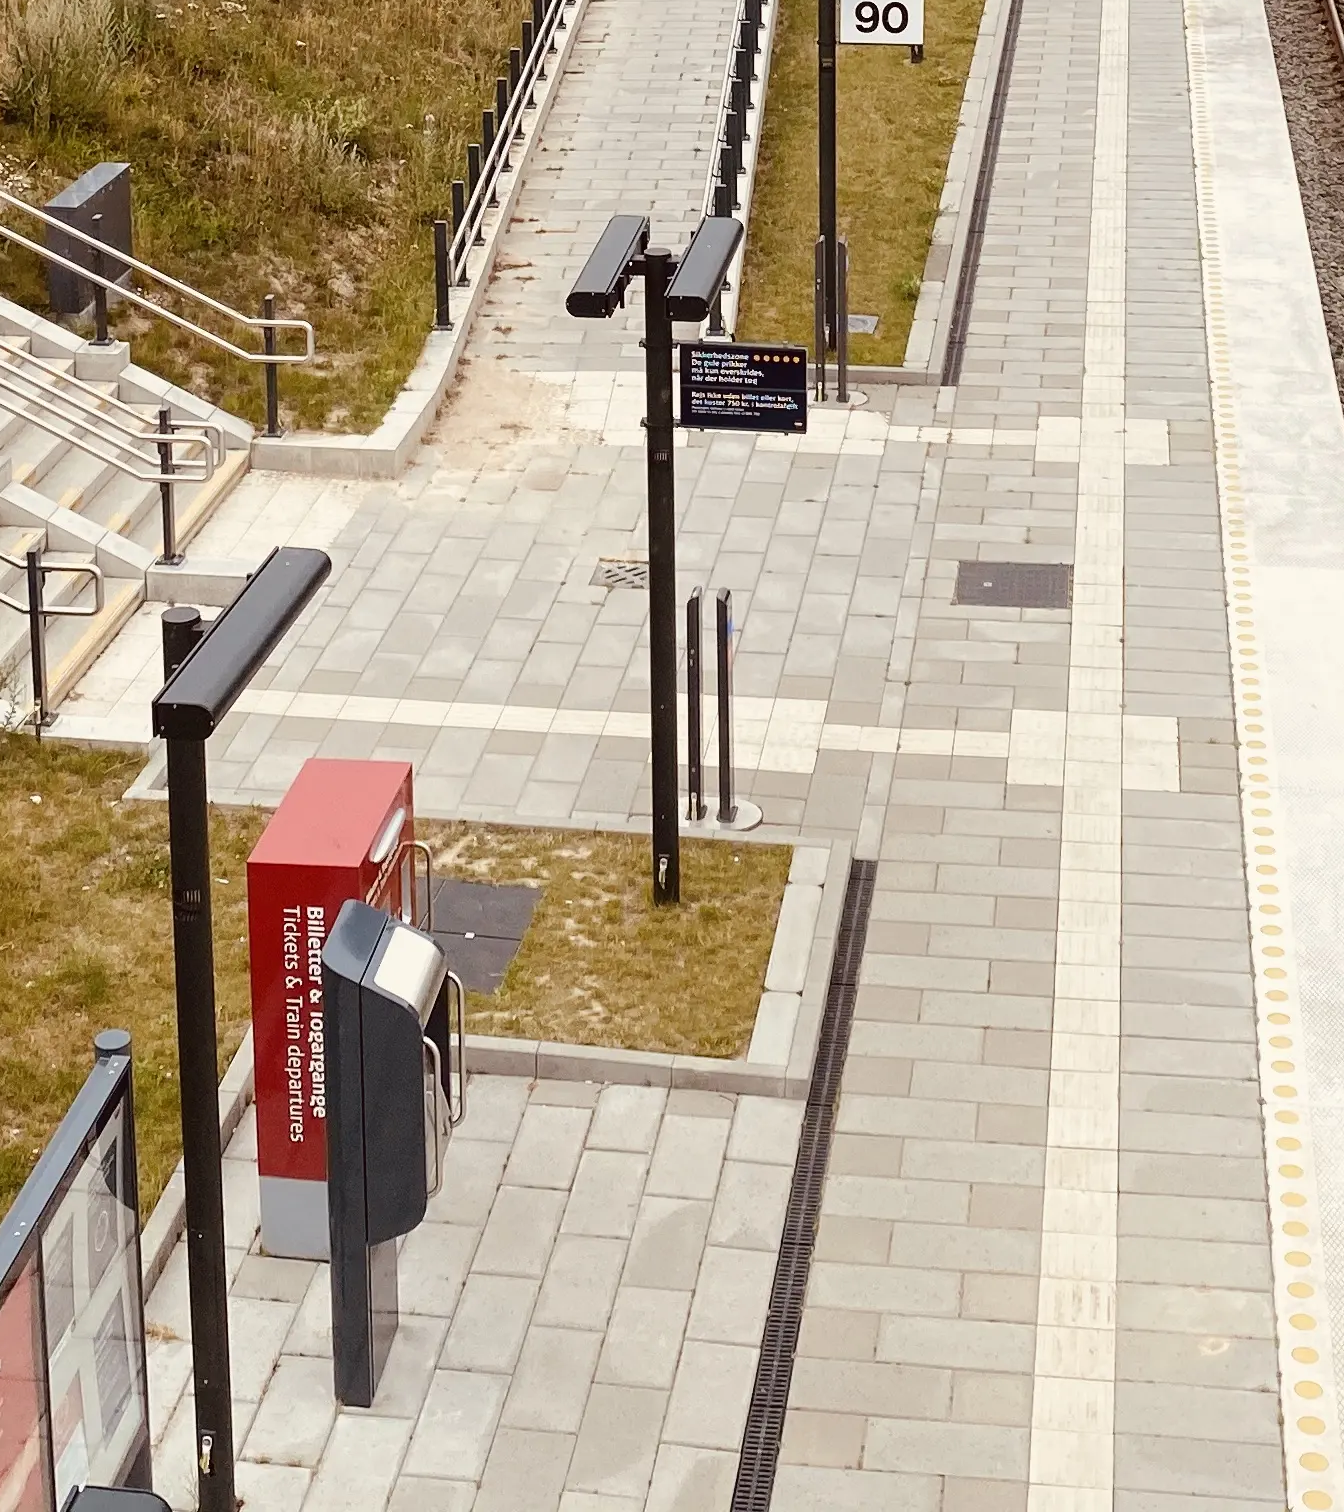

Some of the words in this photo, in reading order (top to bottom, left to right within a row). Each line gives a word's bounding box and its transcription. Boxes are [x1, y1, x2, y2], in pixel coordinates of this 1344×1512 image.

[855, 1, 909, 34] 90
[691, 350, 749, 361] Sikkerhedszone
[704, 374, 718, 382] der
[718, 375, 743, 384] holder
[283, 905, 302, 970] Tickets
[306, 906, 326, 985] Billetter
[285, 976, 303, 989] &
[286, 996, 304, 1040] Train
[284, 1045, 304, 1143] departures
